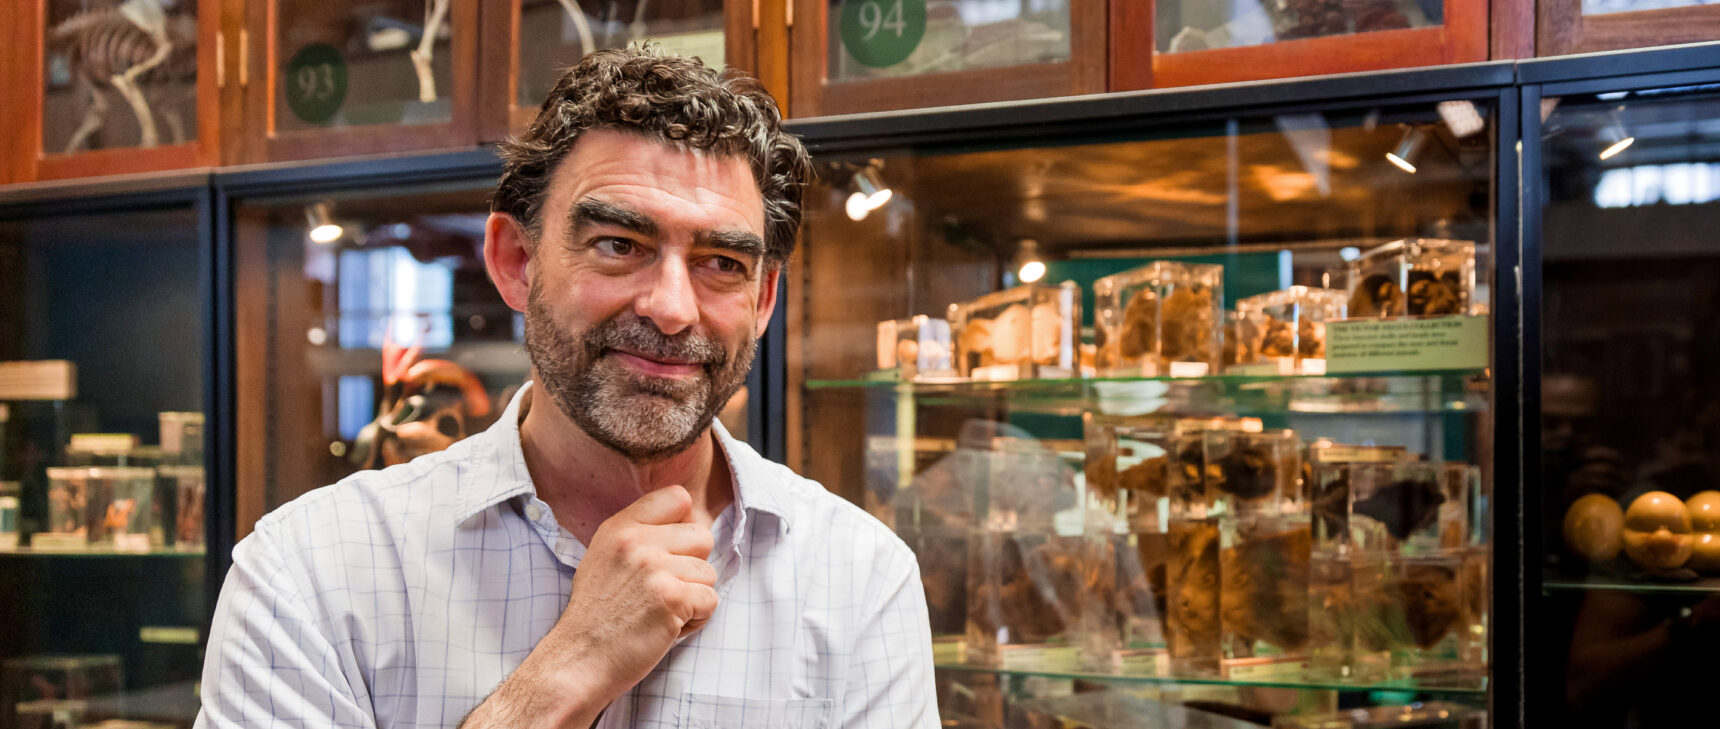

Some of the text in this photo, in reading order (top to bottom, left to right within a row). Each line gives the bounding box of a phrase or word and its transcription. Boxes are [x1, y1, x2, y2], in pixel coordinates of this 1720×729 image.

[859, 0, 907, 41] 94
[298, 65, 334, 99] 93
[1410, 321, 1463, 330] COLLECTION
